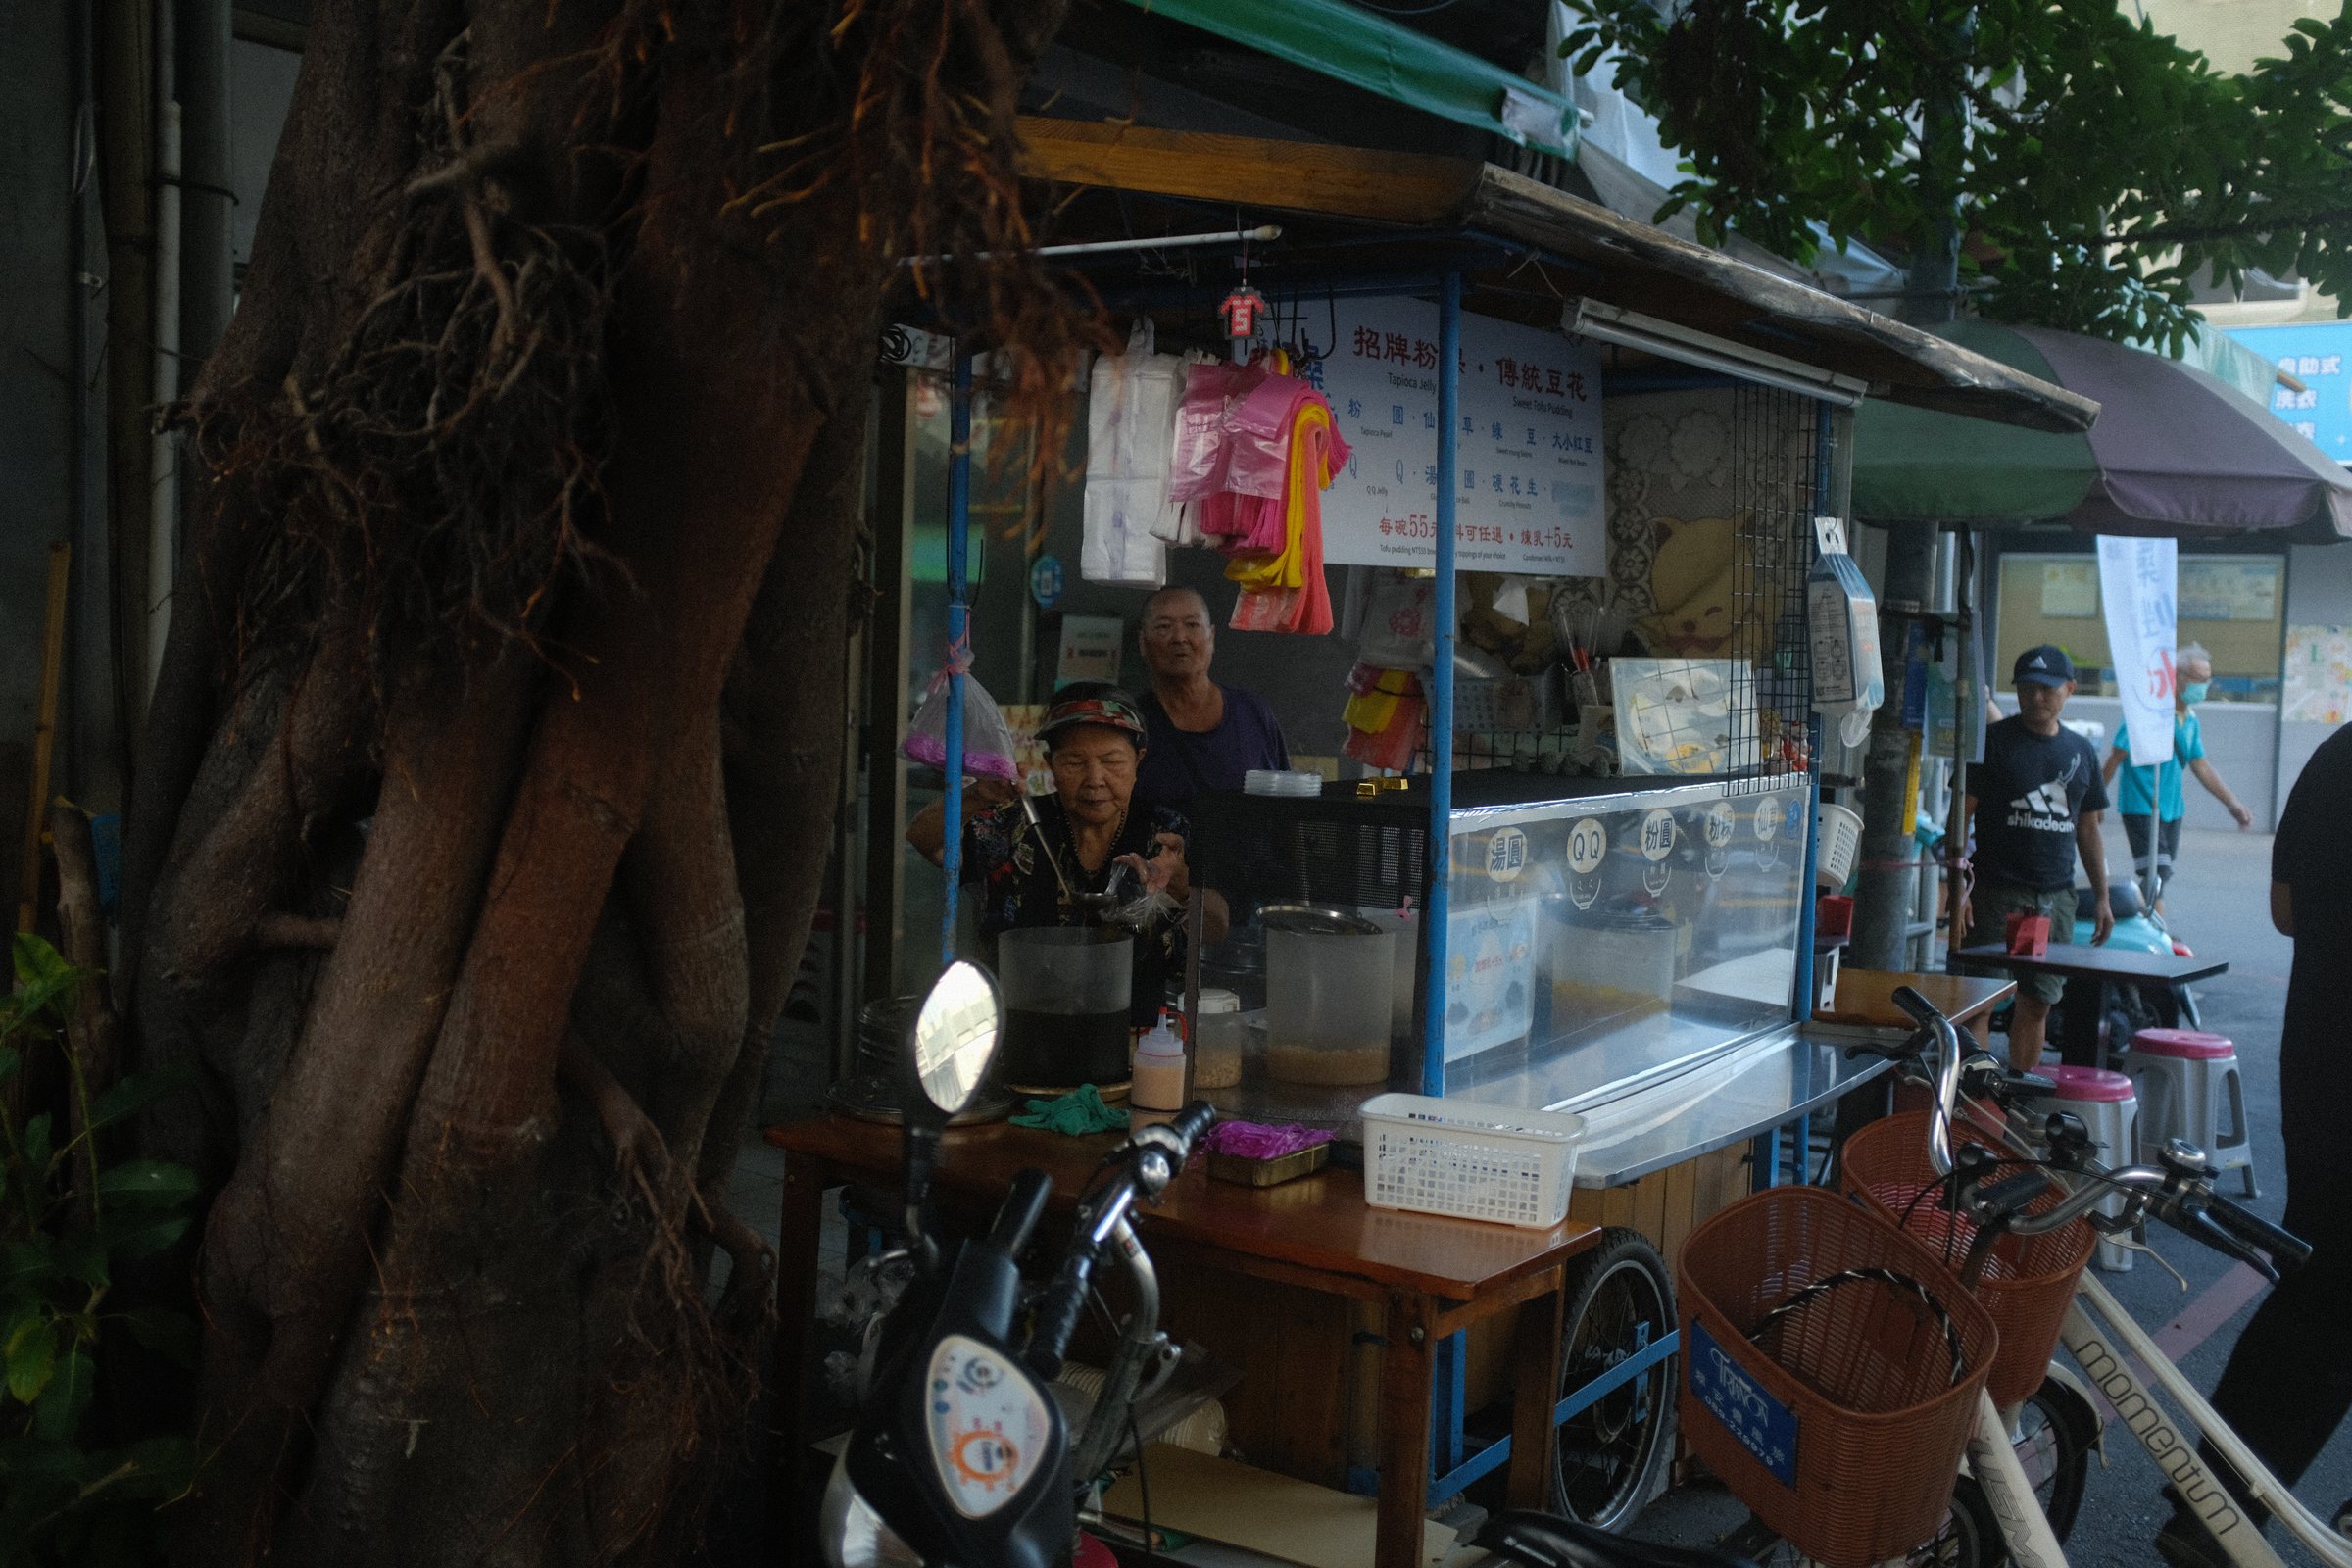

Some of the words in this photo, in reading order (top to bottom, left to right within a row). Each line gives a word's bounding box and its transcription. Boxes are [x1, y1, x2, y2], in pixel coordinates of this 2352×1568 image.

[1389, 372, 1418, 389] Tapioca
[1419, 377, 1437, 394] Jelly
[1495, 356, 1587, 401] 傳統豆花
[1512, 396, 1533, 409] Sweet
[1645, 818, 1672, 851] 粉圓
[1491, 834, 1523, 871] 湯圓
[2076, 1340, 2241, 1536] momentum
